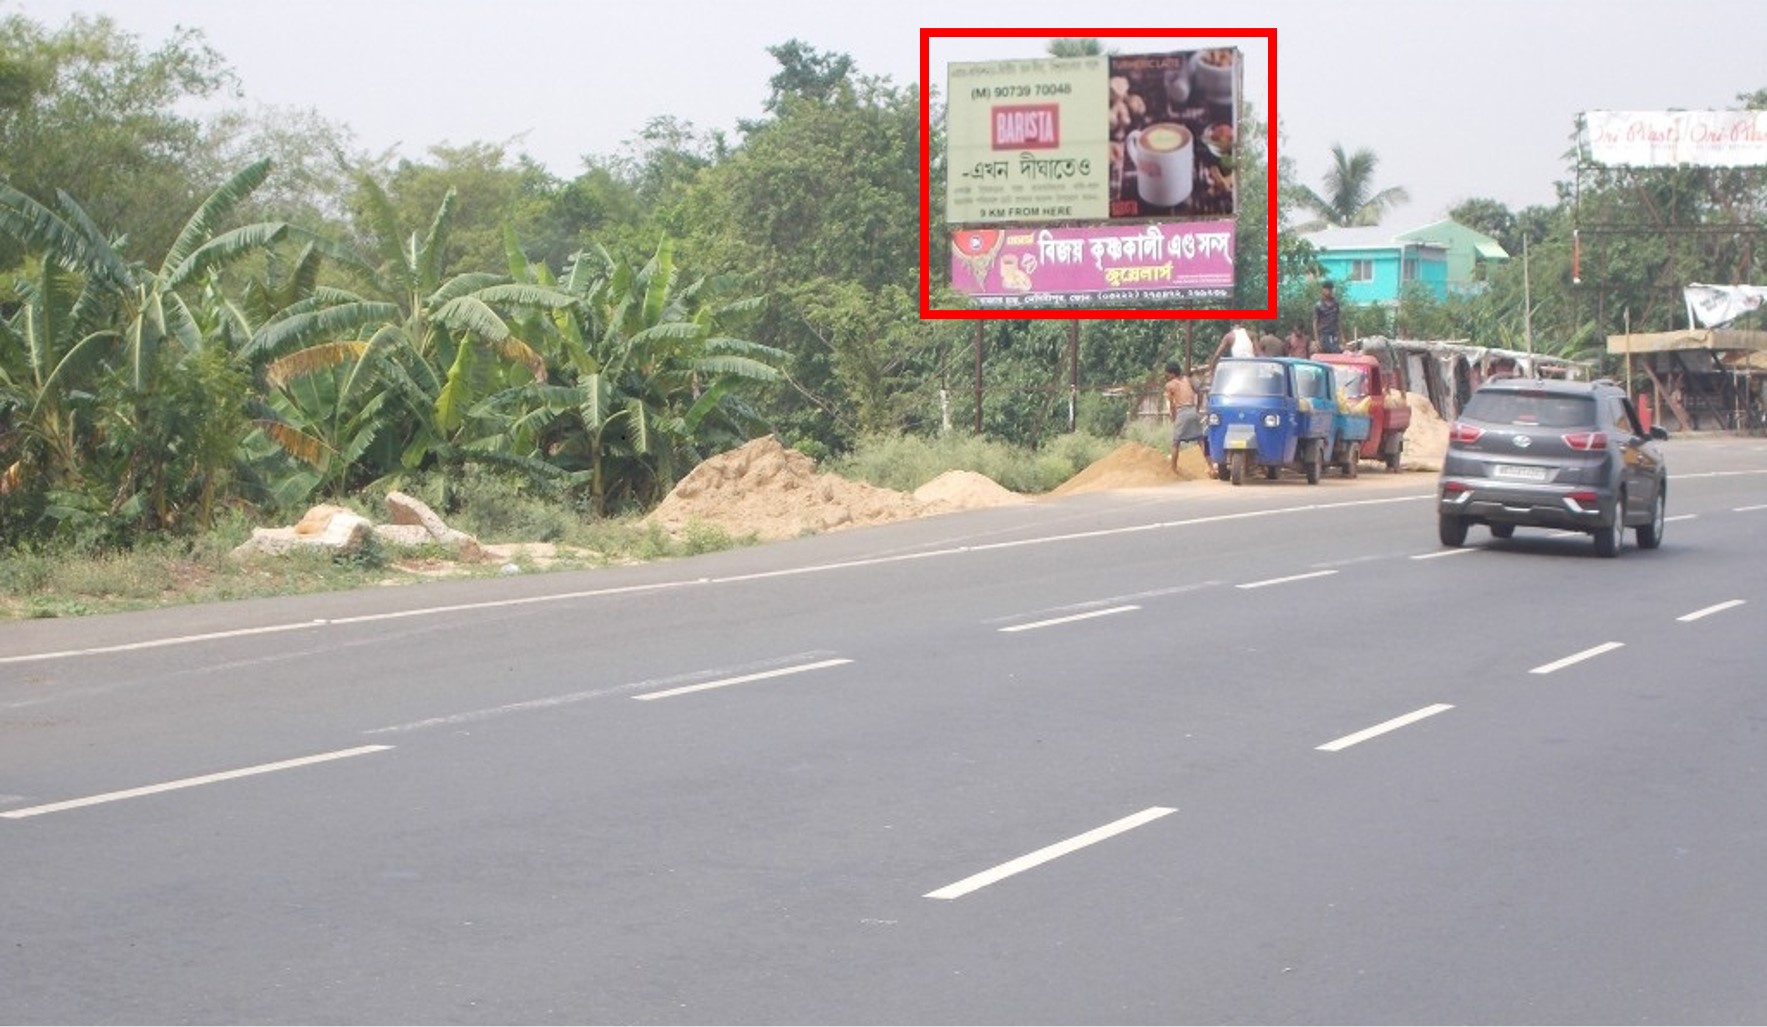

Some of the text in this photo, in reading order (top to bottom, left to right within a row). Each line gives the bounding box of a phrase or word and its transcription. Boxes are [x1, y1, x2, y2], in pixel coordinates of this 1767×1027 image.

[971, 83, 1072, 100] (M) 90739 70048
[997, 111, 1054, 144] BARISTA
[1019, 151, 1091, 179] দীঘাতেও
[988, 209, 1005, 217] KM
[1008, 207, 1040, 217] FROM
[1042, 206, 1072, 215] HERE
[1038, 228, 1084, 265] বিজয়
